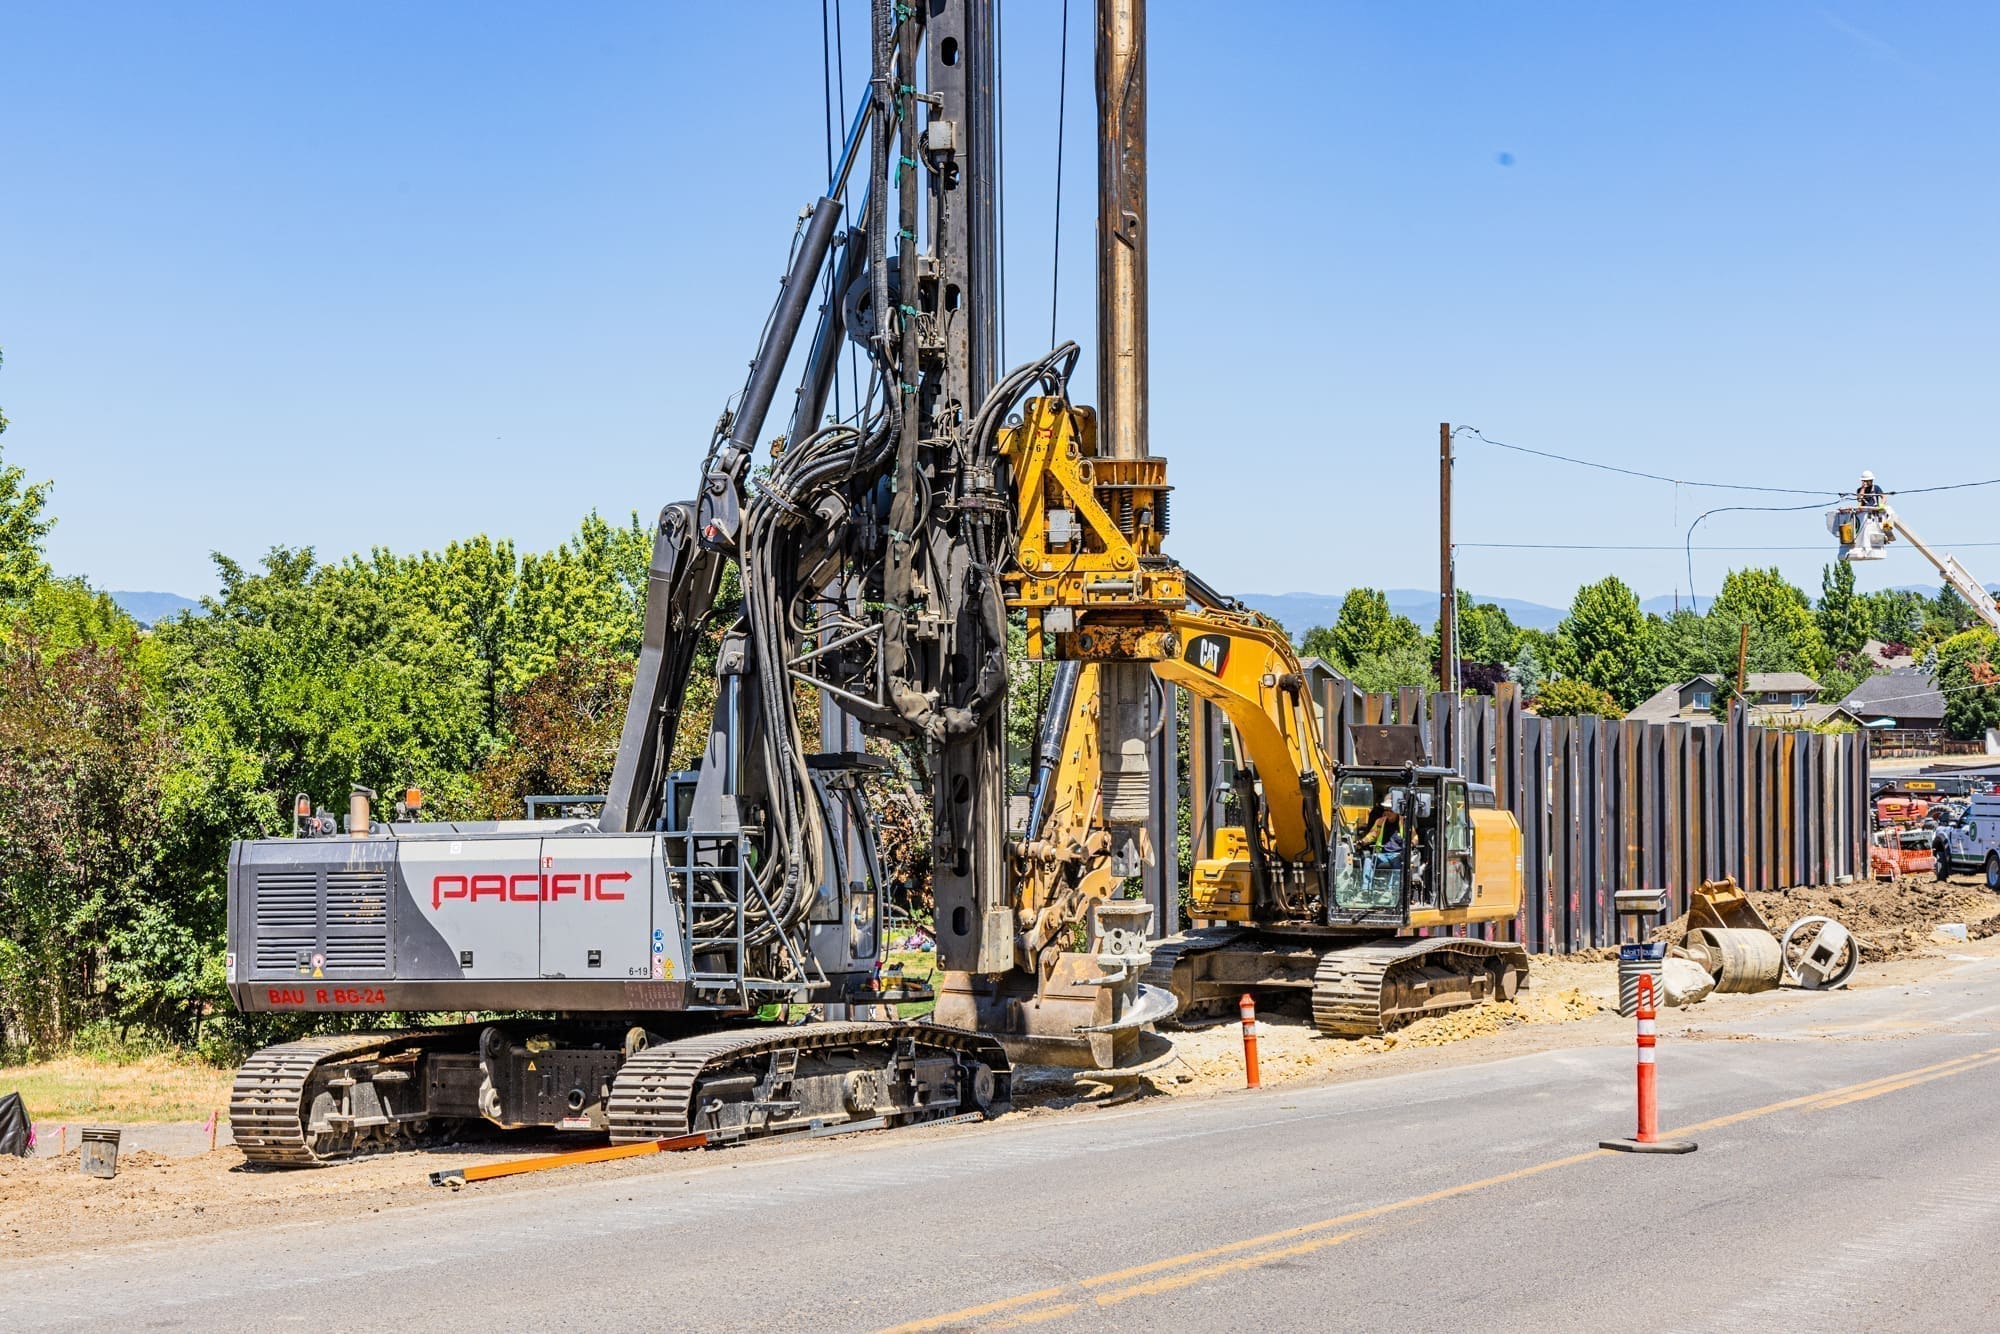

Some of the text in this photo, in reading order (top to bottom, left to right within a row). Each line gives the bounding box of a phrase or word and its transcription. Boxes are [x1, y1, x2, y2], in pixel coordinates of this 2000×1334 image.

[1200, 638, 1220, 674] CAT
[432, 872, 632, 911] PACIFIC
[629, 967, 648, 976] 6-19
[333, 988, 387, 1004] BG-24
